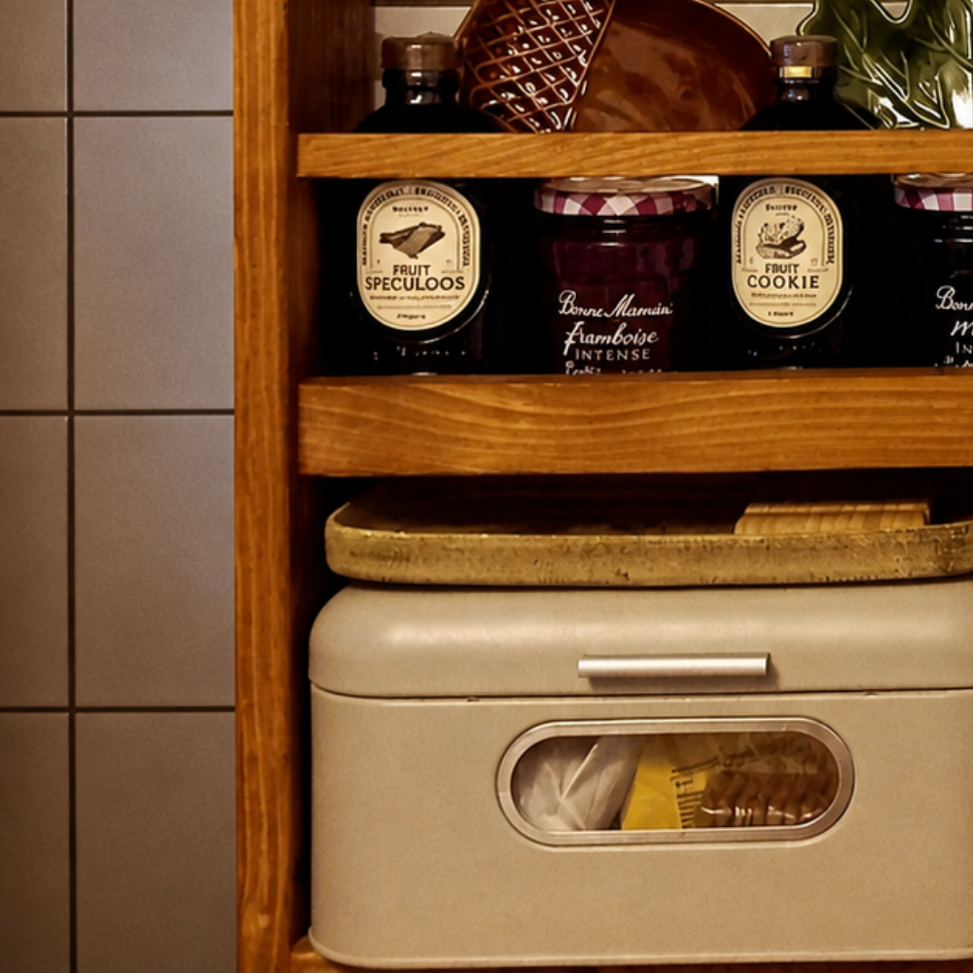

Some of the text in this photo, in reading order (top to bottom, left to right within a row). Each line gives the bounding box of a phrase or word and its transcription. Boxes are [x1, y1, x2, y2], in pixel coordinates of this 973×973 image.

[364, 276, 466, 291] SPECULOOS
[747, 275, 820, 290] COOKIE
[574, 348, 651, 361] INTENSE
